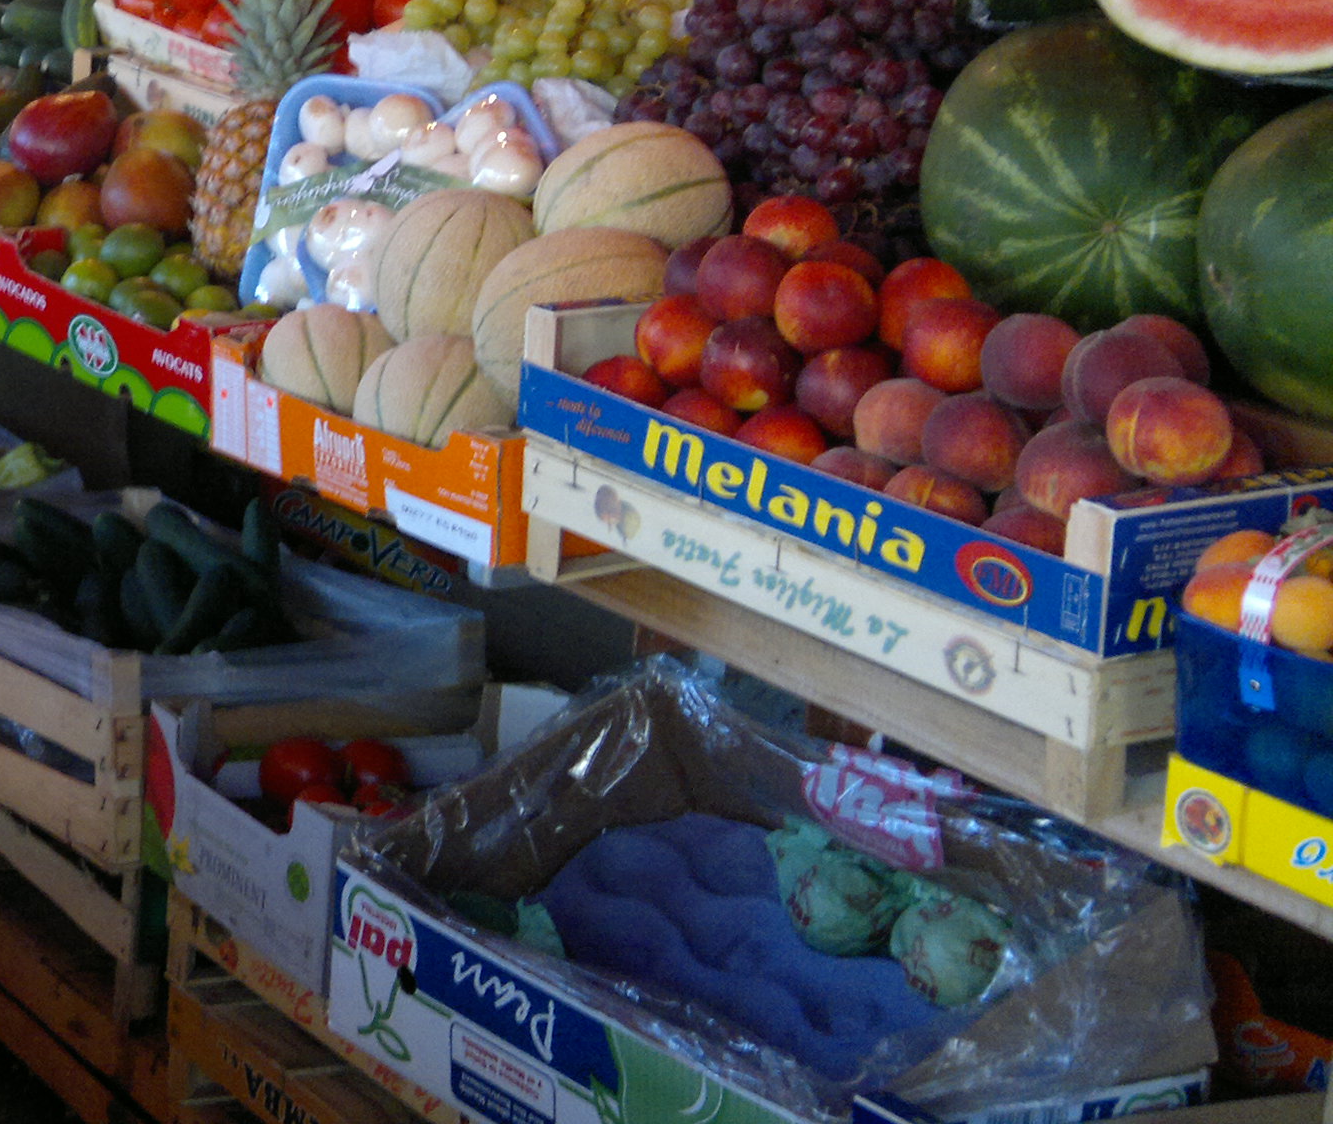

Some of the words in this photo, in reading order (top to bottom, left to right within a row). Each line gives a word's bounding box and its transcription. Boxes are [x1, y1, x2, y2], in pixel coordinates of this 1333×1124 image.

[151, 348, 203, 383] AVOCATS
[642, 417, 926, 573] Melania
[866, 613, 911, 654] La
